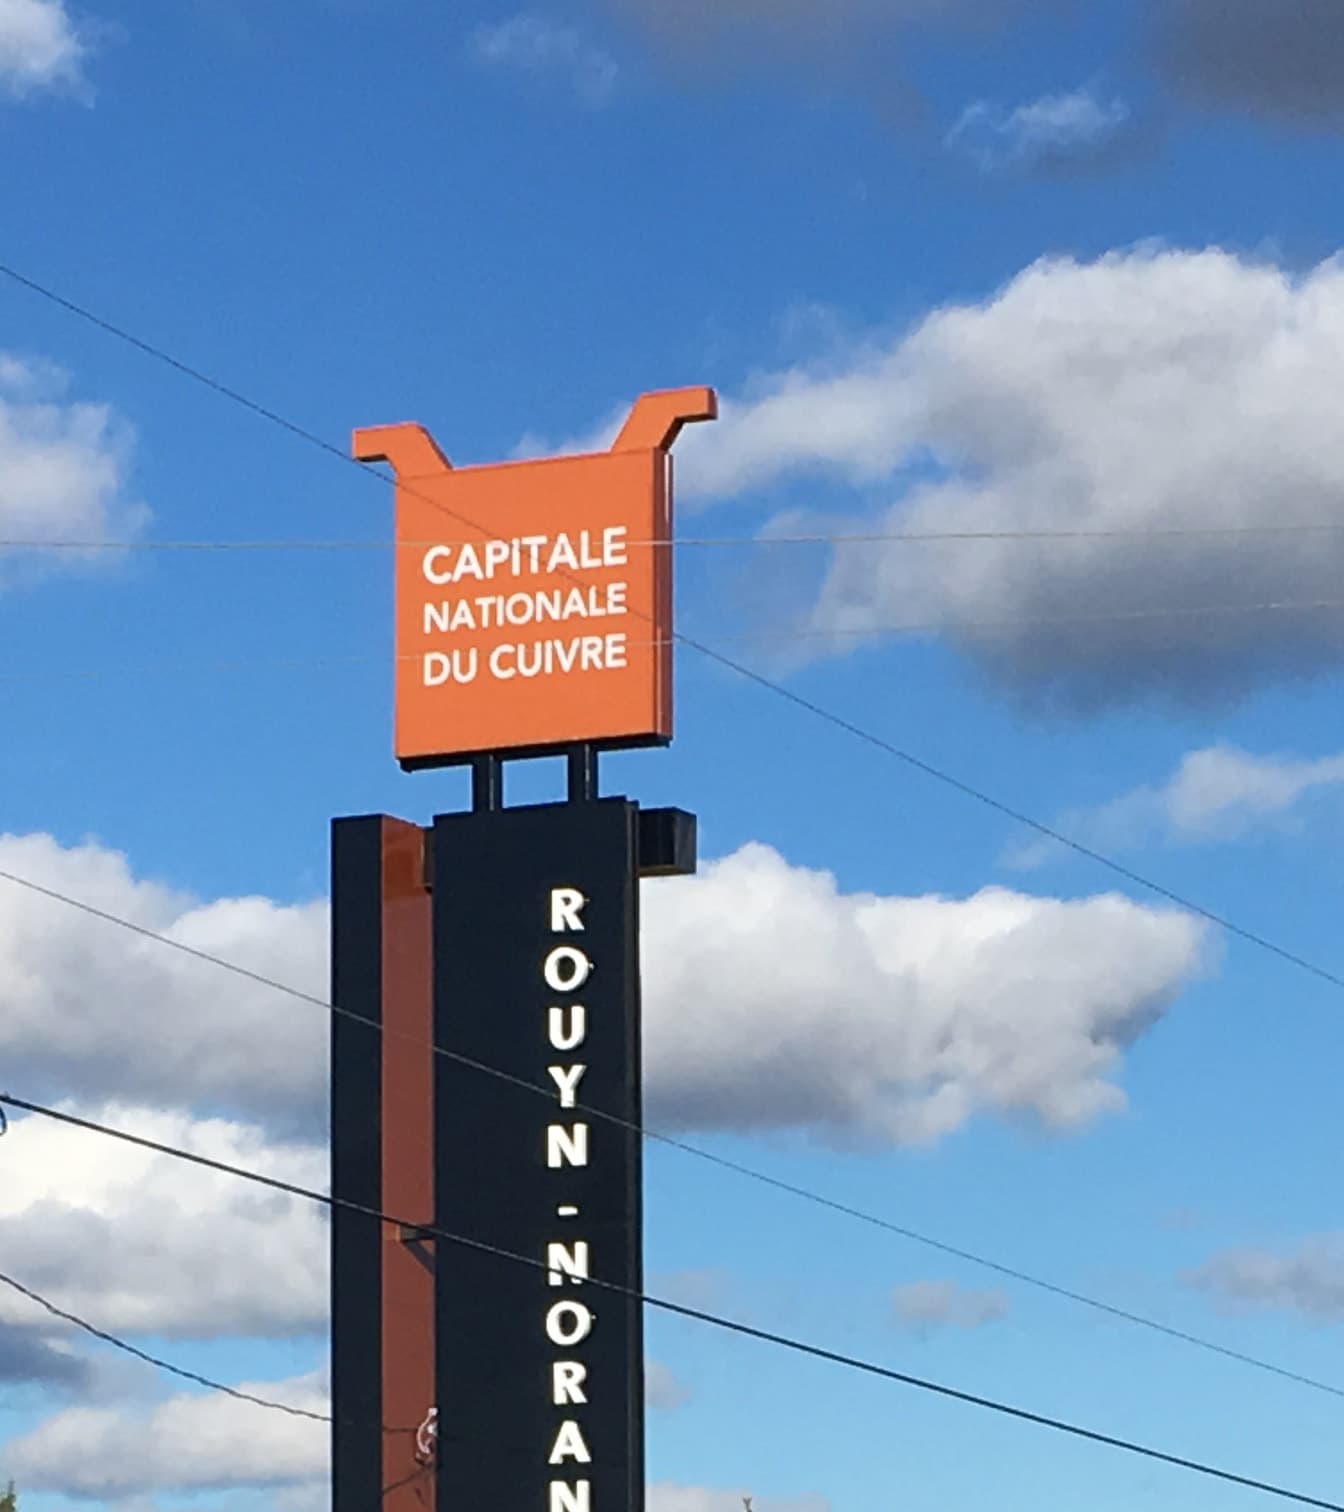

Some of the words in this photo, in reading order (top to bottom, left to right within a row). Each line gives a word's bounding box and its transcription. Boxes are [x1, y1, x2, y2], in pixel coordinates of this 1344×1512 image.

[422, 526, 628, 585] CAPITALE
[423, 582, 627, 634] NATIONALE
[423, 648, 478, 686] DU
[489, 633, 627, 679] CUIVRE
